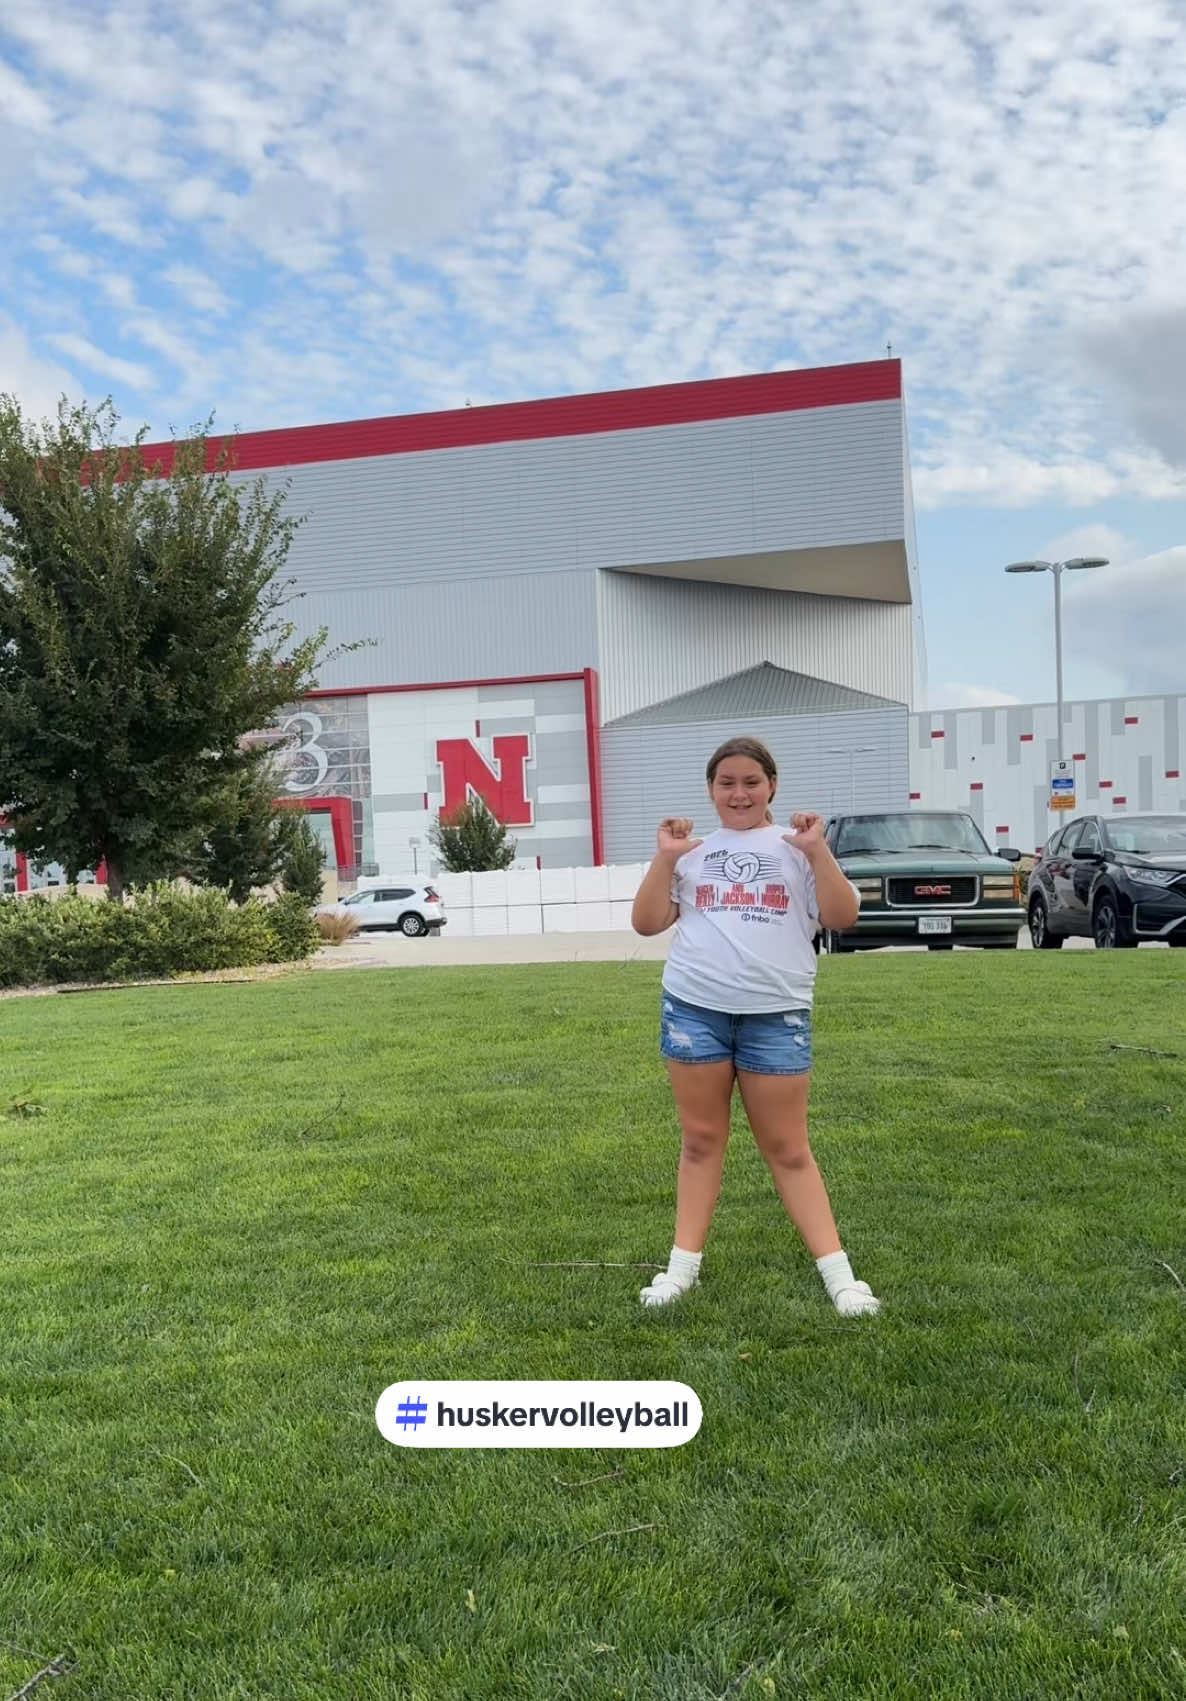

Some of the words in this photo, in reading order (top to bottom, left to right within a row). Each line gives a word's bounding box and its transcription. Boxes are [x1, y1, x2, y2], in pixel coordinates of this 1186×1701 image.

[436, 732, 534, 828] N
[914, 885, 951, 895] GMC
[722, 892, 755, 905] JACKSON
[730, 905, 768, 914] VOLLEYBALL
